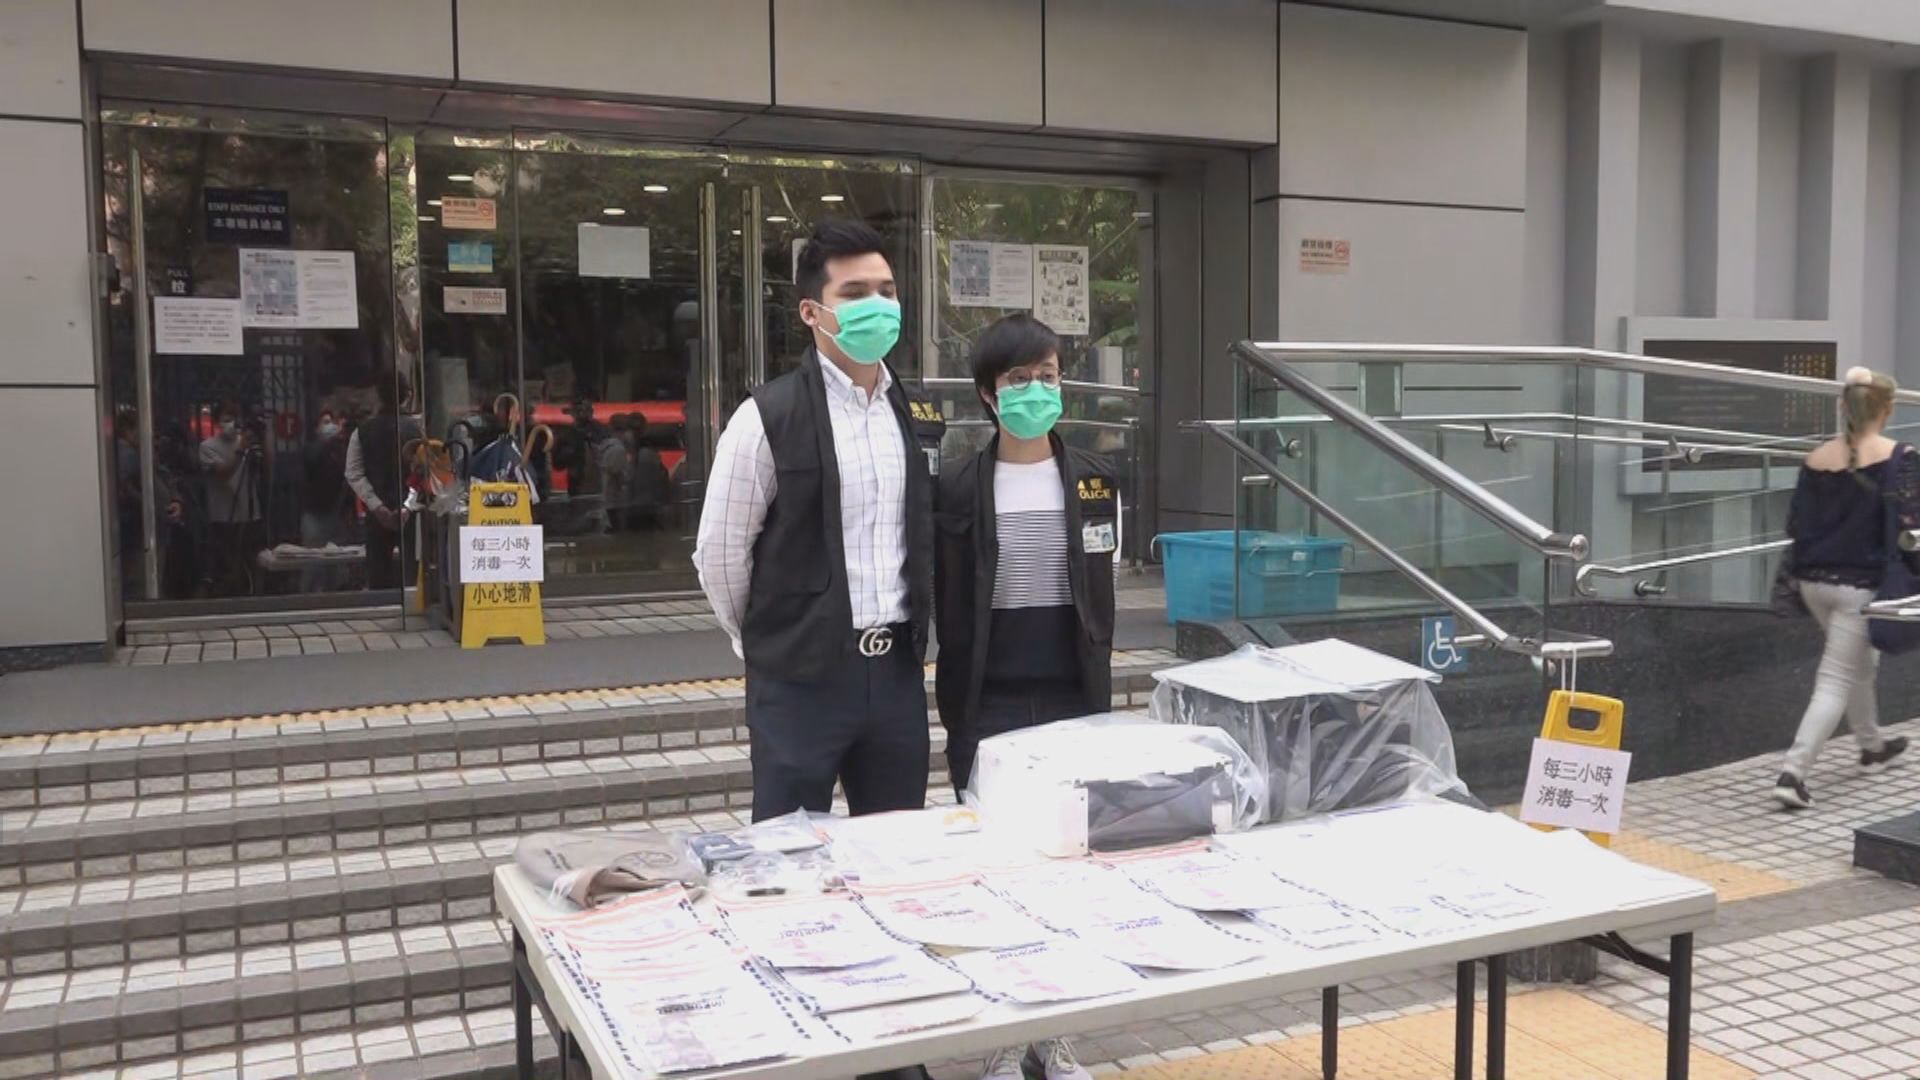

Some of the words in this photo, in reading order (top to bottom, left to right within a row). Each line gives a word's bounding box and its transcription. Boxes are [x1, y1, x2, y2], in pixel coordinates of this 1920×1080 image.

[1079, 488, 1111, 500] OLICE
[471, 537, 530, 551] 每三小時
[471, 555, 531, 571] 消毒一次
[473, 582, 532, 604] 小心地滑
[1543, 757, 1613, 787] 每三小時
[1537, 785, 1609, 815] 消毒一次
